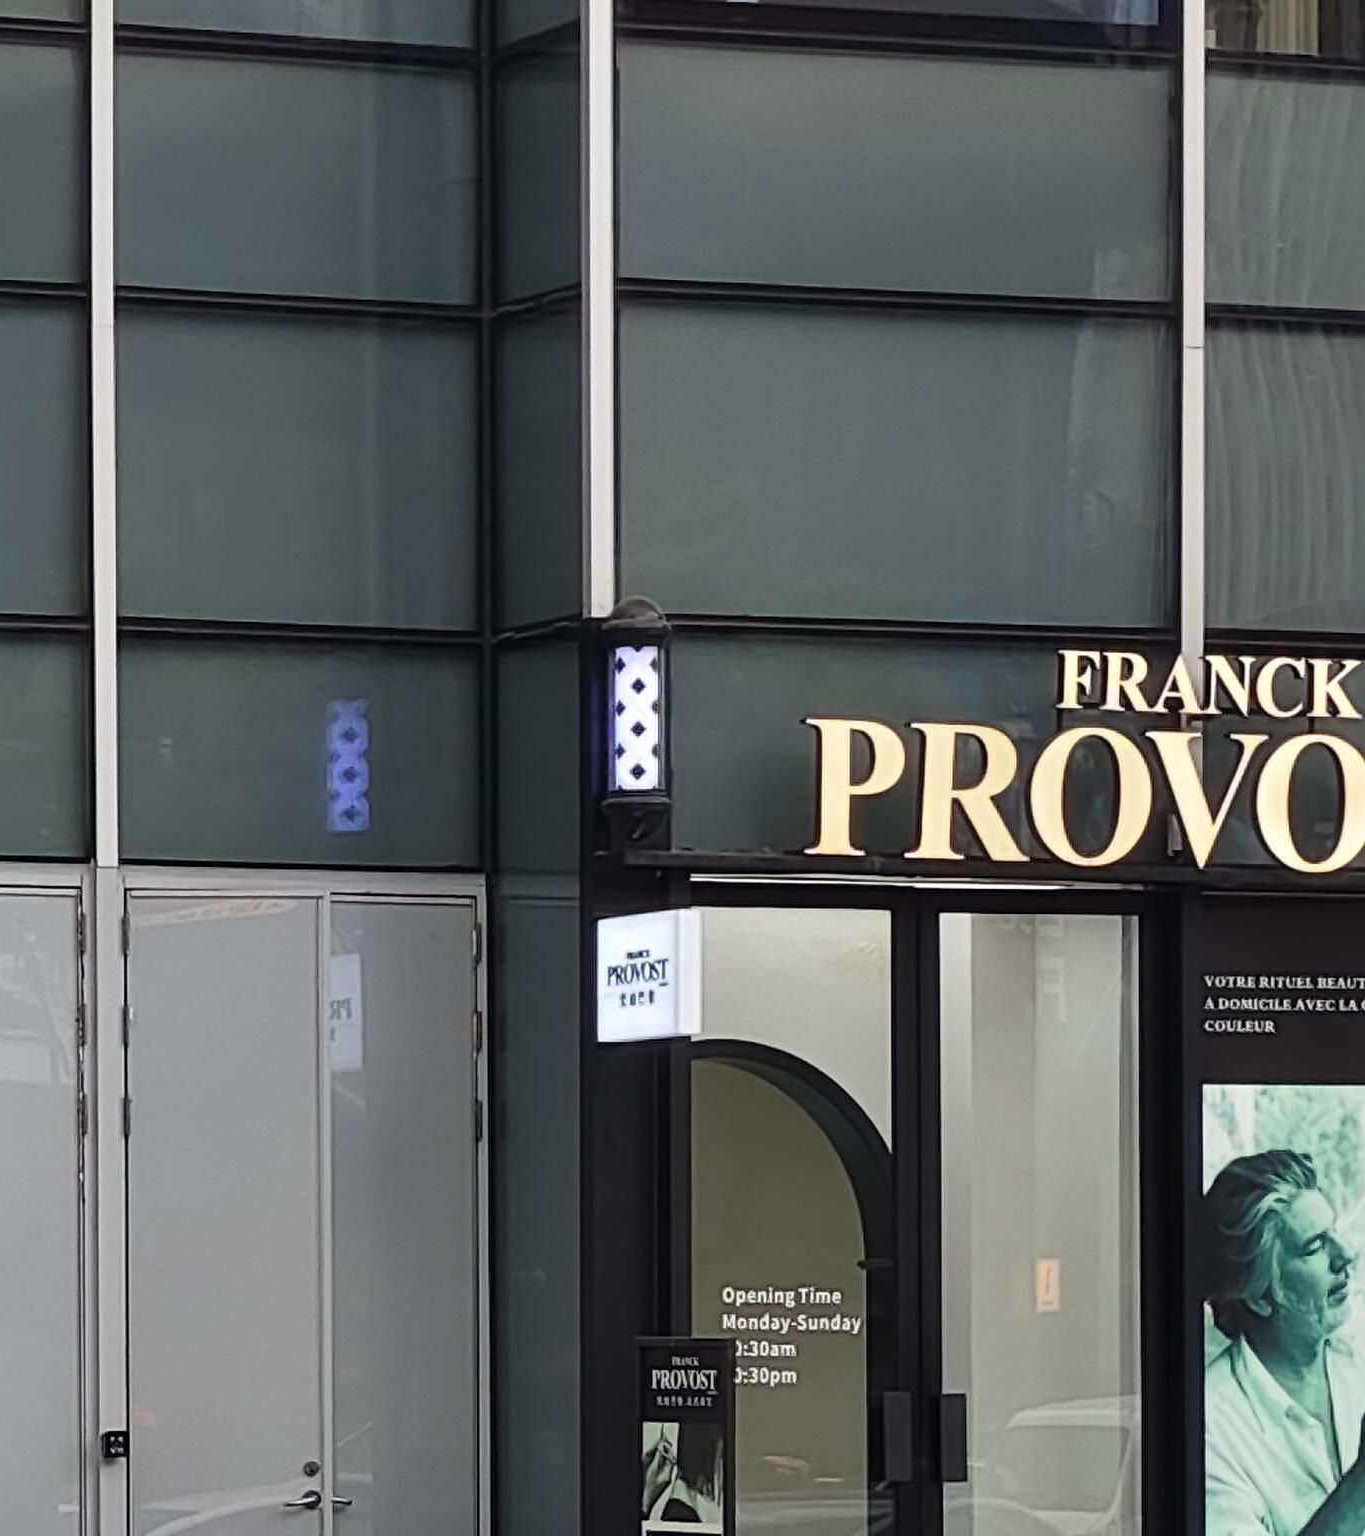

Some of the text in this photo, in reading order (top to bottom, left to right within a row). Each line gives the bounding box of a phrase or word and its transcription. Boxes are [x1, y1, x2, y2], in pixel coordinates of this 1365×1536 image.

[1056, 649, 1362, 719] FRANCK
[803, 717, 1365, 873] PROVO
[607, 958, 669, 987] PROVOST
[1204, 975, 1257, 989] VOTRE
[1259, 976, 1314, 990] RITUEL
[1218, 997, 1292, 1012] DOMICILE
[1293, 998, 1335, 1012] AVEC
[1338, 999, 1359, 1012] LA
[1204, 1019, 1277, 1034] COULEUR
[722, 1286, 843, 1308] Opening Time
[722, 1312, 862, 1335] Monday-Sunday
[735, 1340, 797, 1357] 0:30am
[651, 1369, 718, 1390] PROVOST
[734, 1366, 797, 1387] 0:30pm
